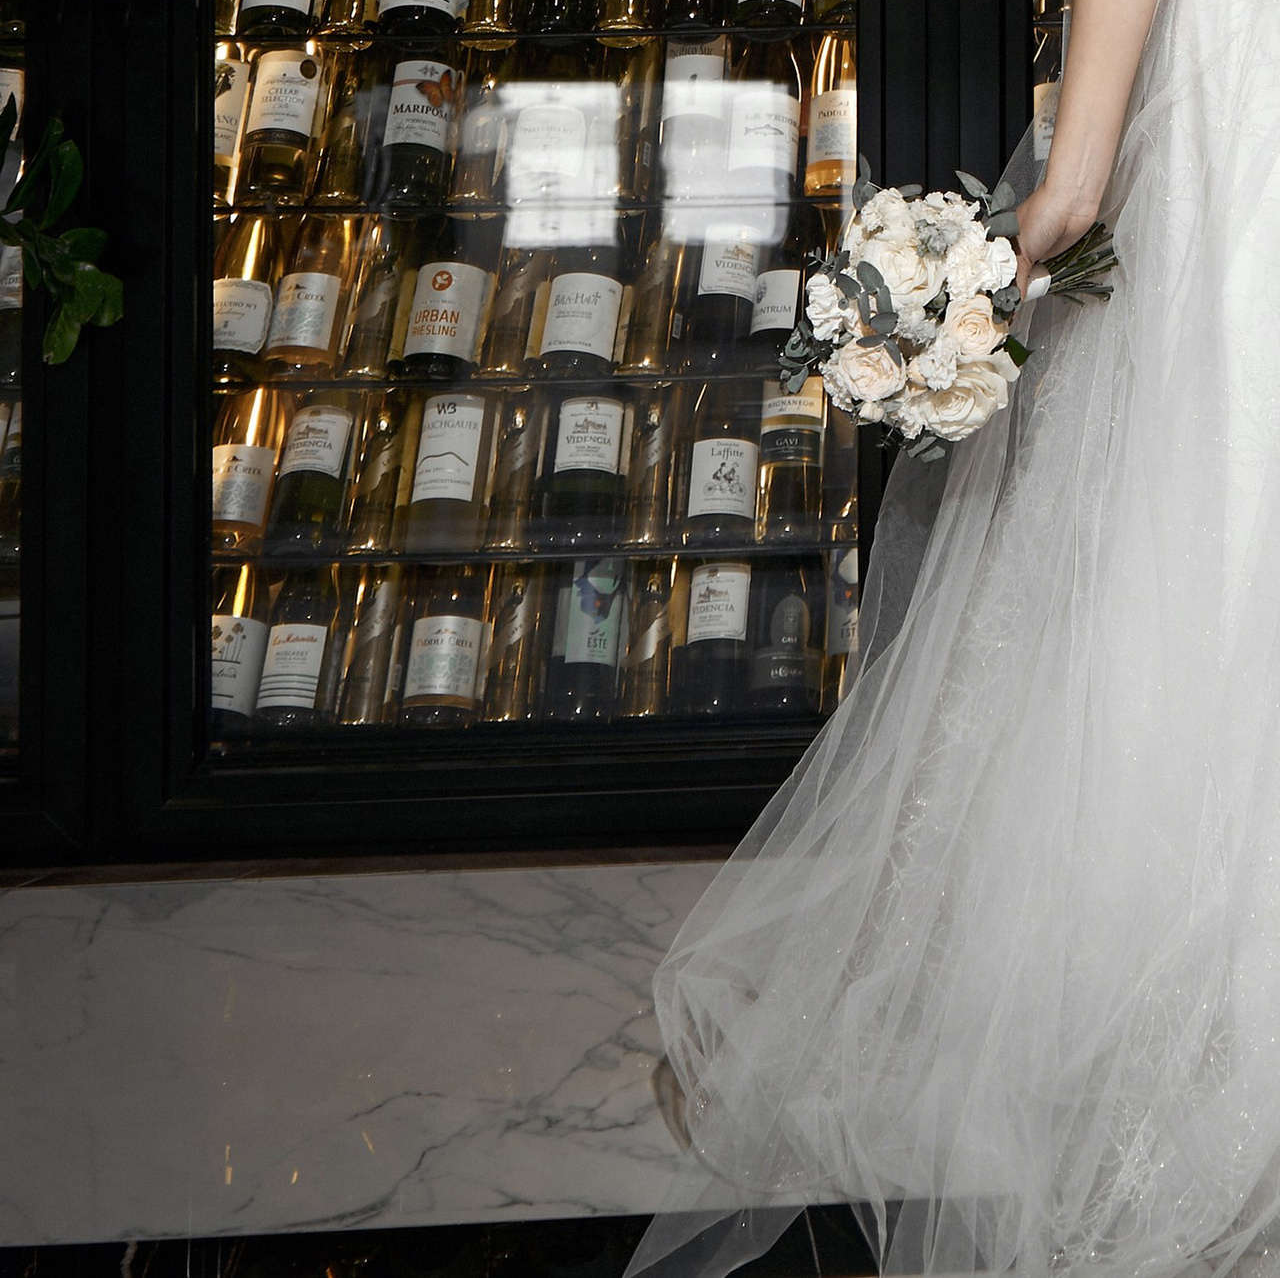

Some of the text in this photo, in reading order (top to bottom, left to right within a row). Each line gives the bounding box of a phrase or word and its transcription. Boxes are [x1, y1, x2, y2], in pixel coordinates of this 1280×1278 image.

[268, 86, 300, 96] CELLAR
[261, 94, 306, 106] SELECTION
[392, 102, 448, 122] MARIPOSA
[296, 291, 327, 303] CREEK
[414, 308, 461, 325] URBAN
[411, 324, 458, 339] RIESLING
[436, 401, 458, 415] WB
[288, 439, 333, 453] VIDENCIA
[565, 435, 612, 447] VIDENCIA
[775, 437, 799, 447] GAVI
[710, 447, 745, 461] Laffitte
[691, 603, 736, 615] VIDENCIA
[586, 636, 608, 650] ESTE
